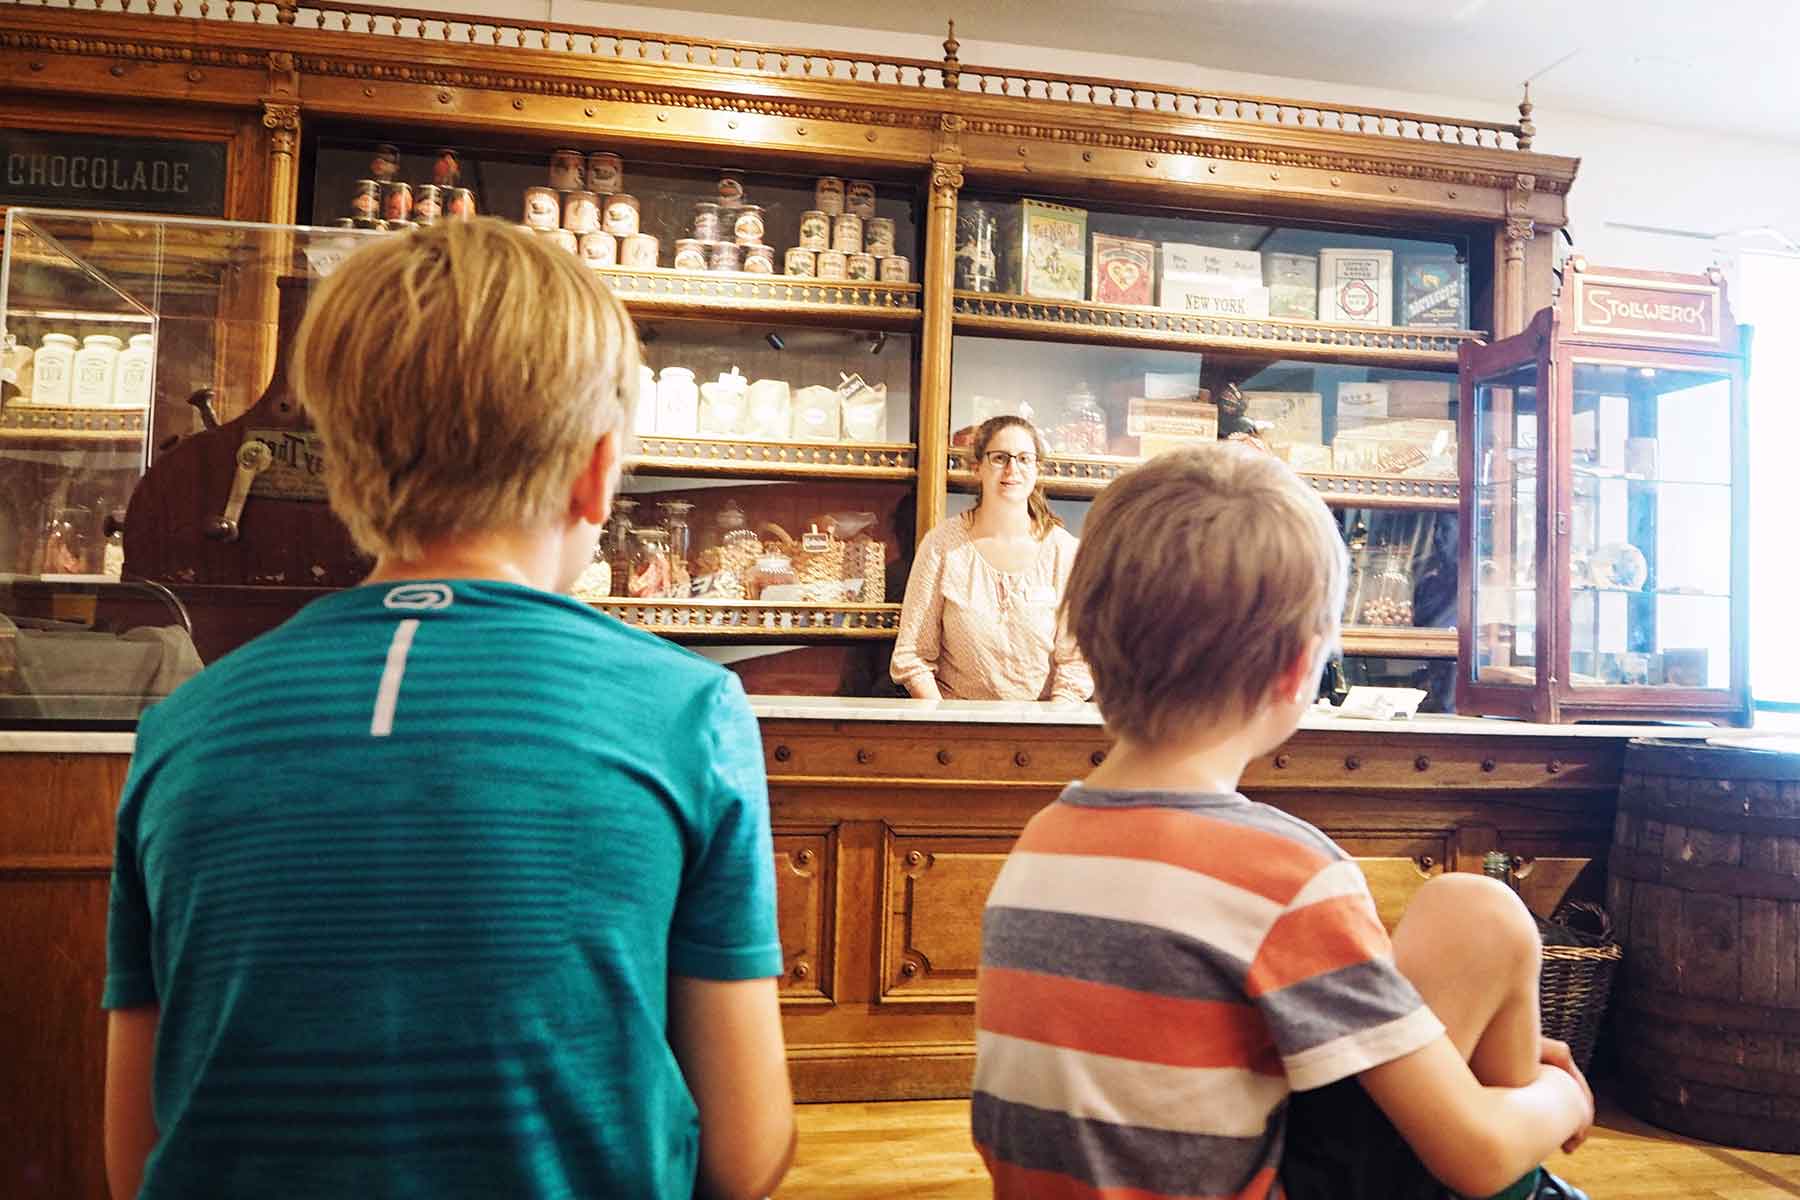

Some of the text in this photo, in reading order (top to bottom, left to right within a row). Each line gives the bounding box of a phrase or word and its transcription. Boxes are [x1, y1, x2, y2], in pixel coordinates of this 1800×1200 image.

[7, 152, 190, 193] CHOCOLADE
[1184, 293, 1247, 315] NEW YORK
